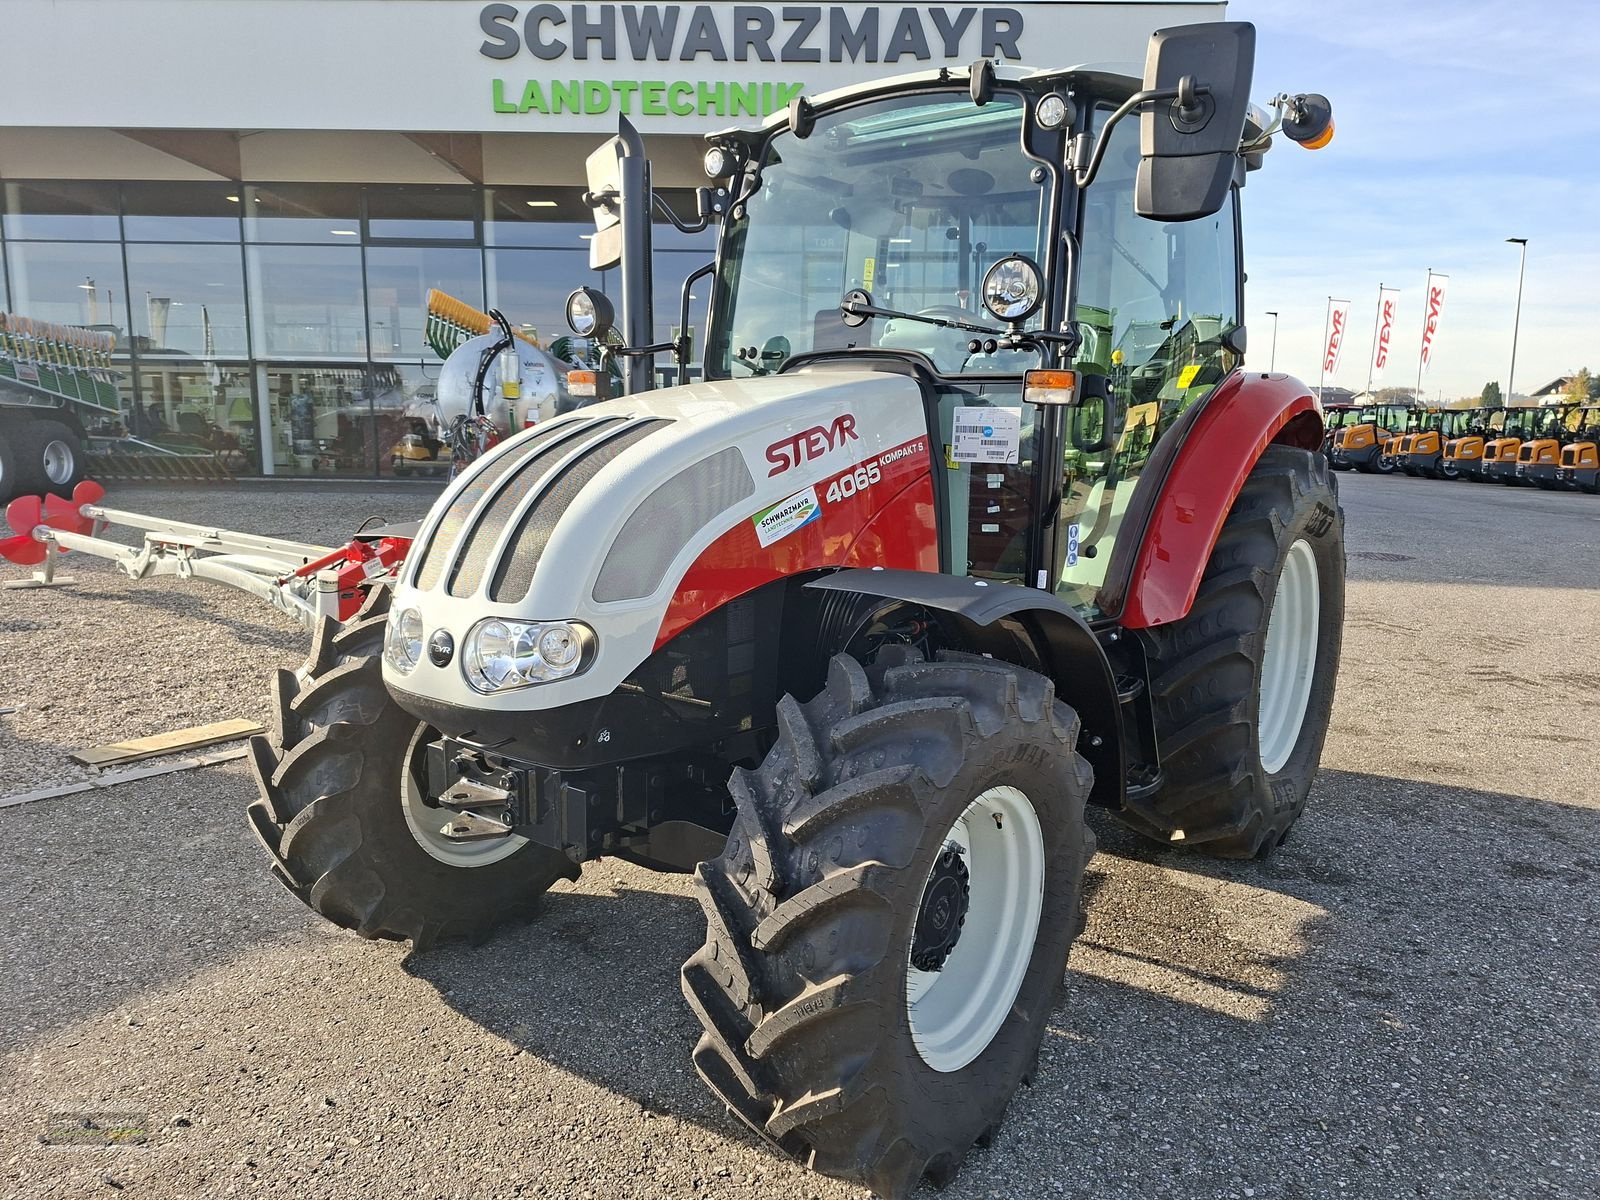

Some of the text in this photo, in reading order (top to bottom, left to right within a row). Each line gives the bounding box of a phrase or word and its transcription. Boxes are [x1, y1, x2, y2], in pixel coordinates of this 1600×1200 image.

[479, 3, 1024, 64] SCHWARZMAYR
[492, 78, 805, 117] LANDTECHNIK
[1324, 309, 1344, 374] STEYR
[1376, 299, 1393, 370] STEYR
[1422, 286, 1442, 364] STEYR
[765, 413, 860, 479] STEYR
[879, 442, 924, 467] KOMPAKT S
[761, 497, 810, 528] SCHWARZMAYR
[825, 461, 881, 504] 4065
